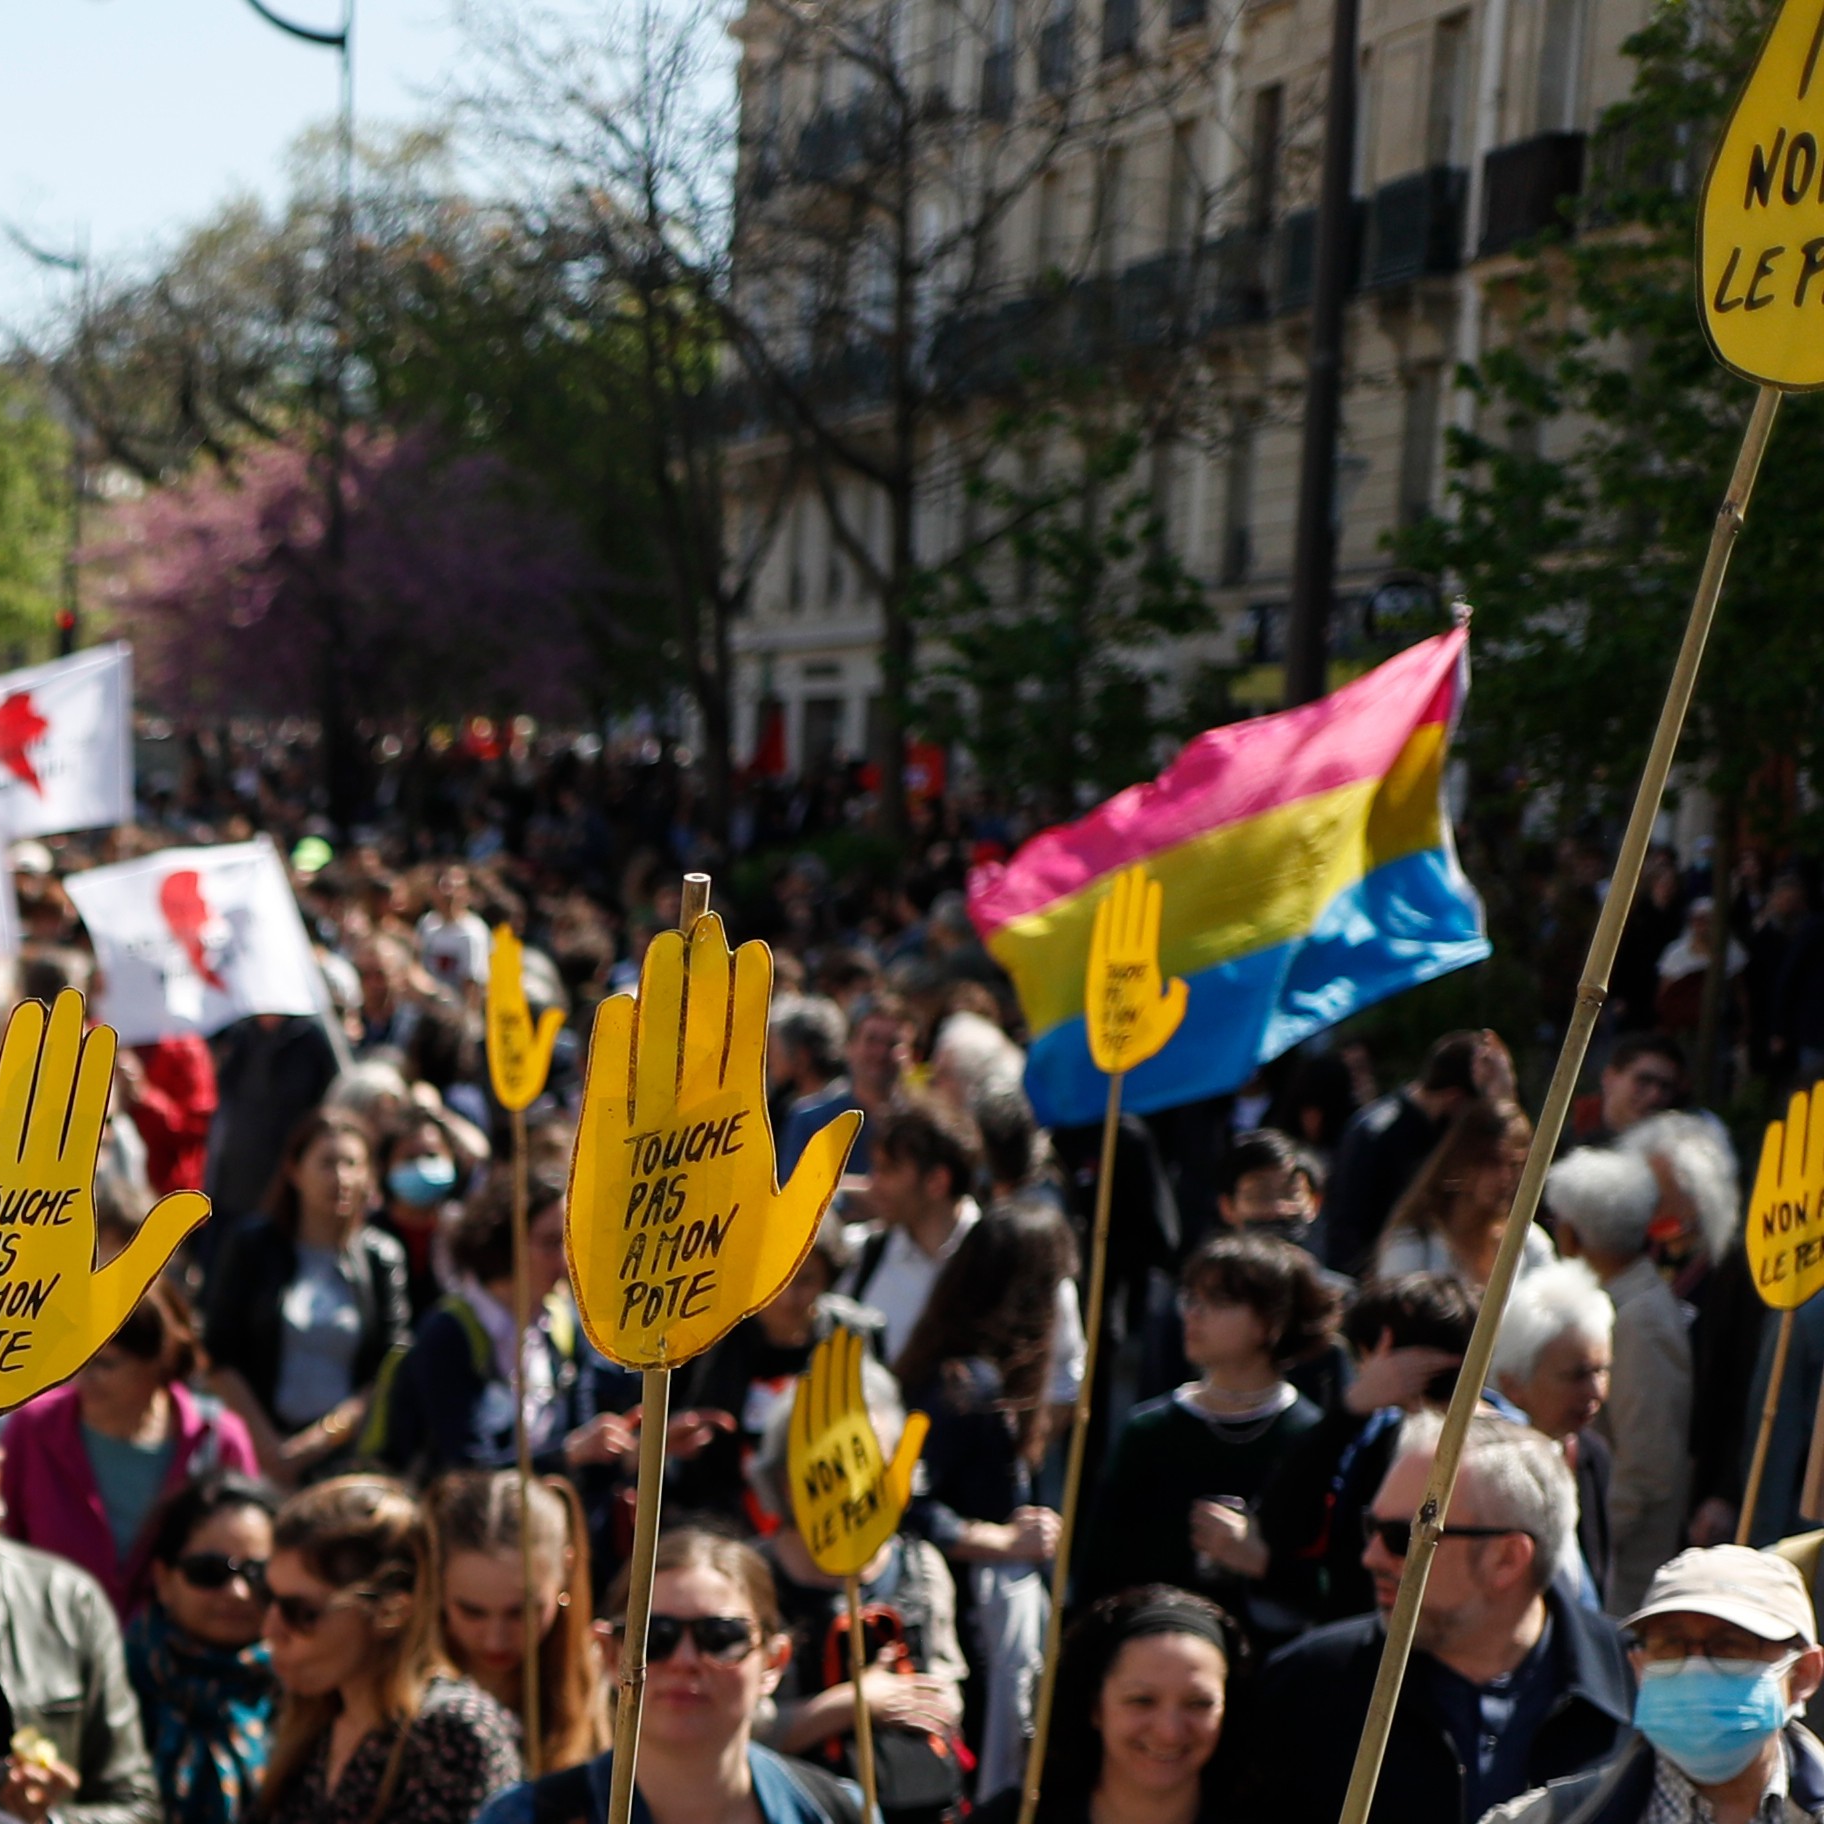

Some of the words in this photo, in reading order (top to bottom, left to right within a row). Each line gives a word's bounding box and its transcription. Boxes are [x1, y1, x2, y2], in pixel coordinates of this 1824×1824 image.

[1744, 127, 1824, 210] NO
[1714, 246, 1785, 313] LE
[1793, 237, 1824, 307] P
[623, 1108, 751, 1176] TOUCHE
[623, 1171, 687, 1233] PAS
[1763, 1191, 1808, 1239] NON
[619, 1232, 648, 1279] A
[652, 1202, 741, 1279] MON
[1760, 1252, 1787, 1287] LE
[619, 1268, 718, 1332] POTE
[804, 1440, 847, 1503] NON
[812, 1509, 838, 1557] LE
